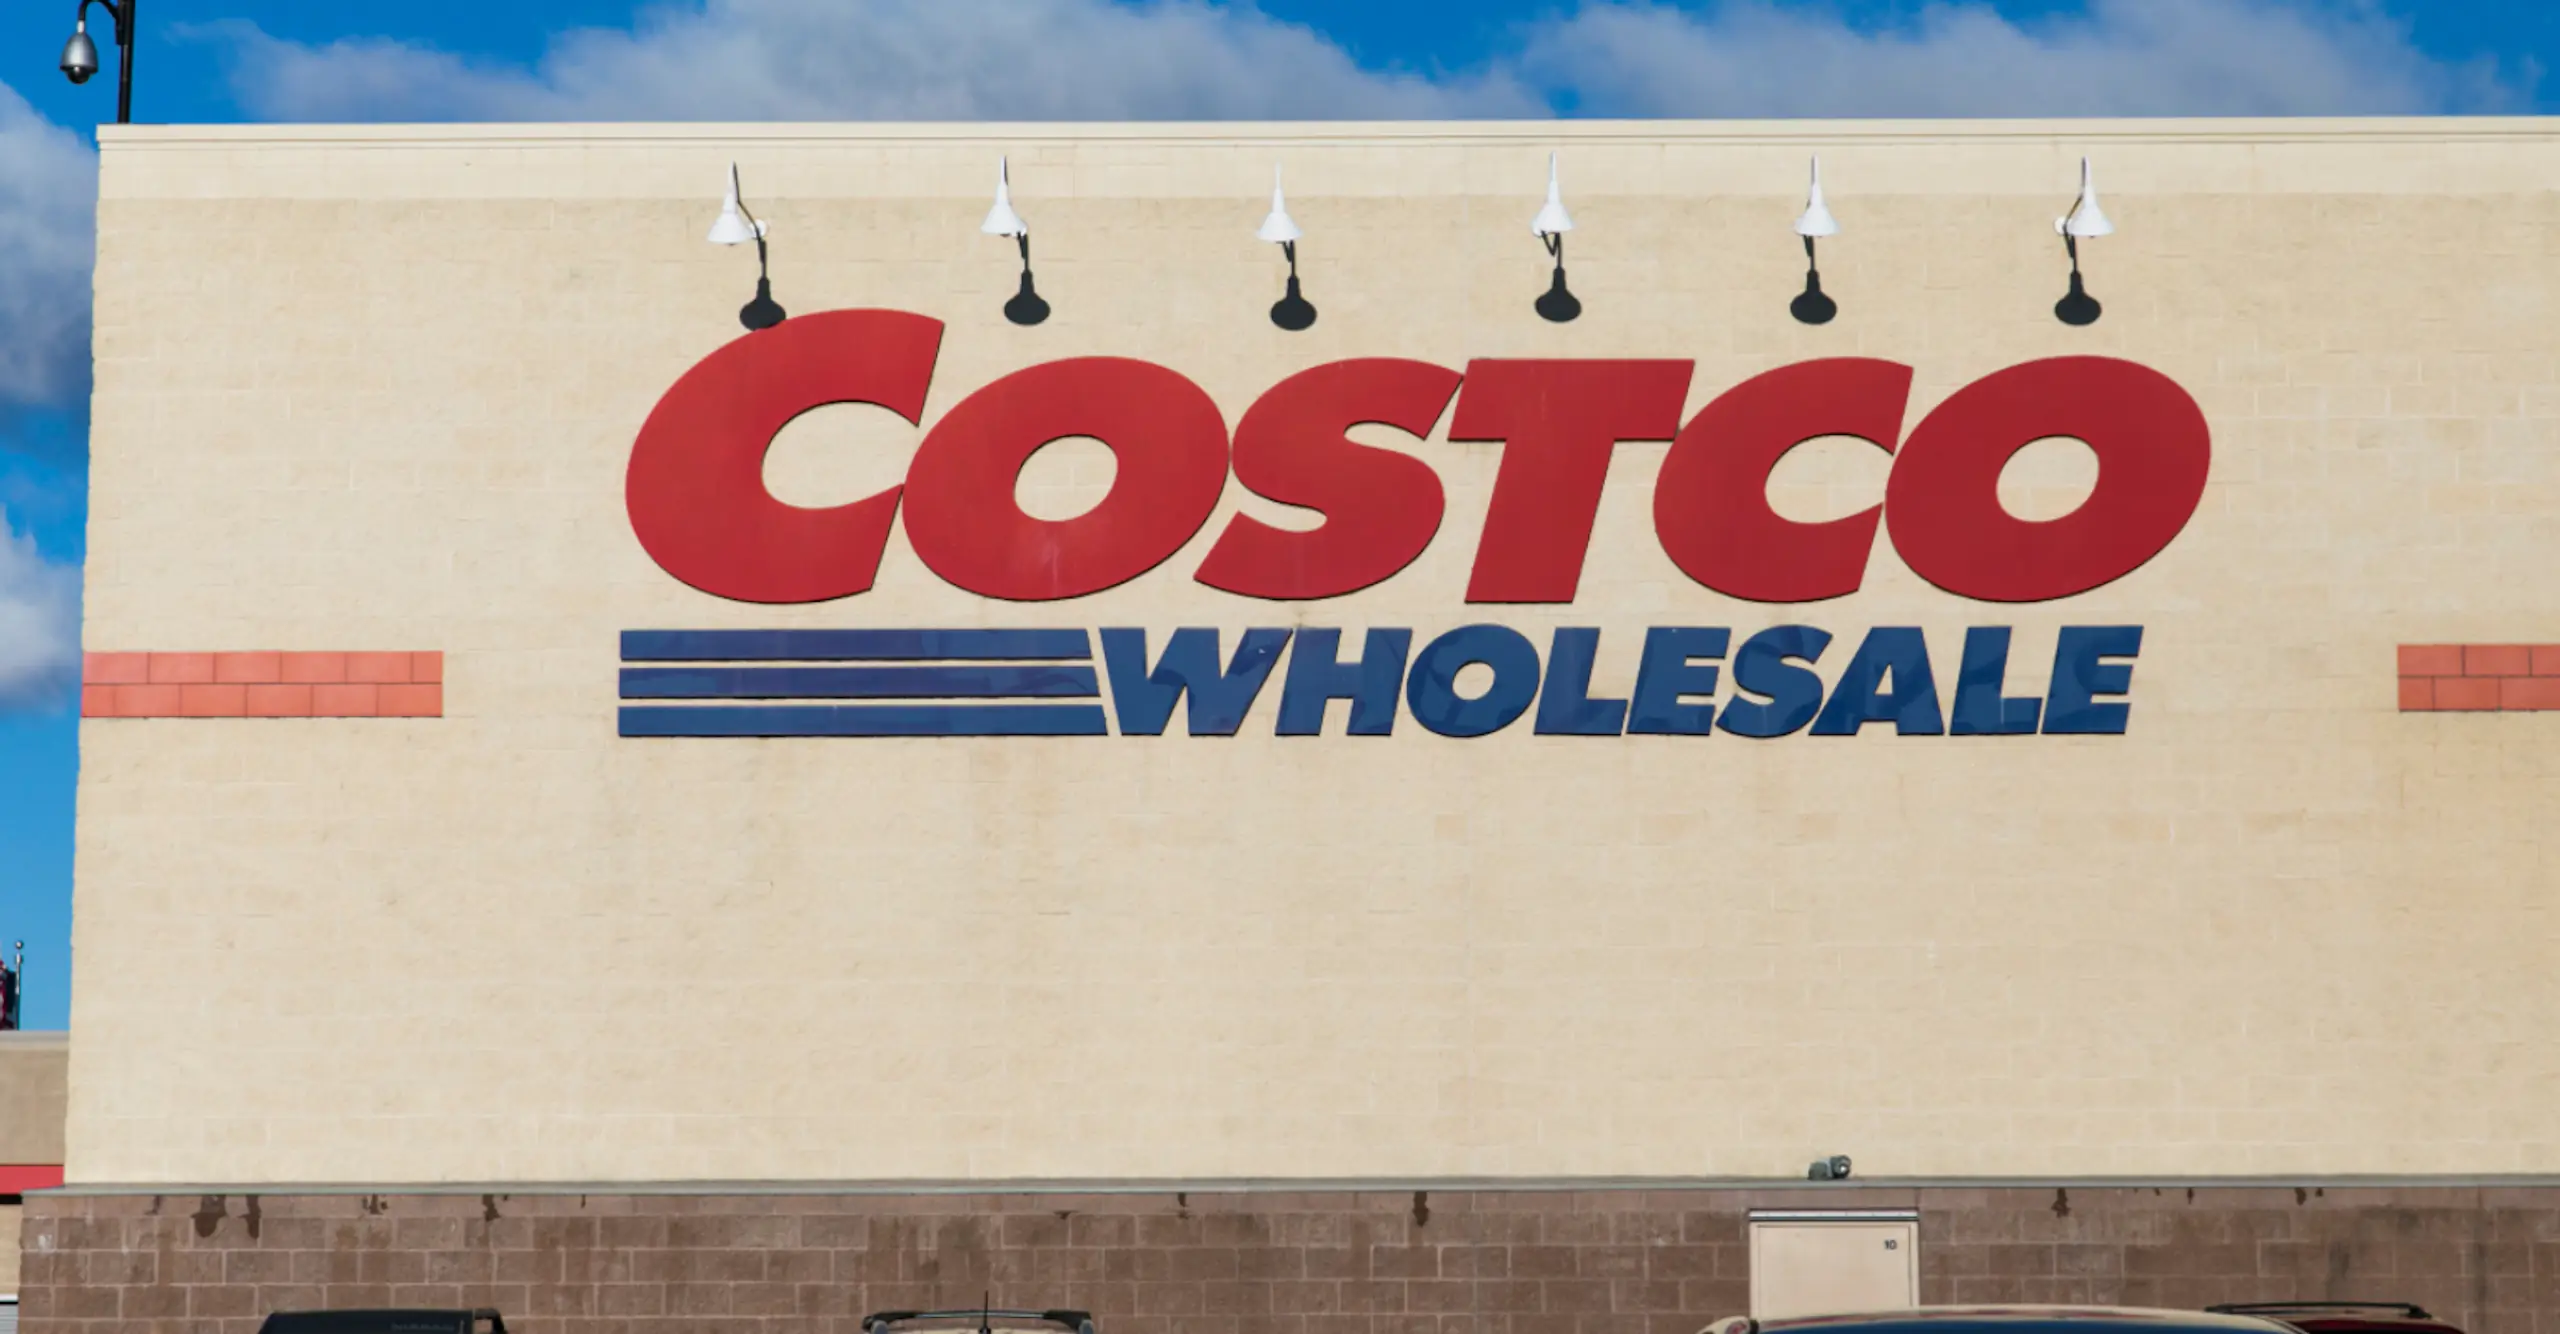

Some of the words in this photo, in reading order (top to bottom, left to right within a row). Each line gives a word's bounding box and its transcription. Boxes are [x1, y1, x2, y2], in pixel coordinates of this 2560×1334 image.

[626, 309, 2211, 604] COSTCO
[1099, 624, 2142, 737] WHOLESALE
[1884, 1239, 1897, 1250] 10
